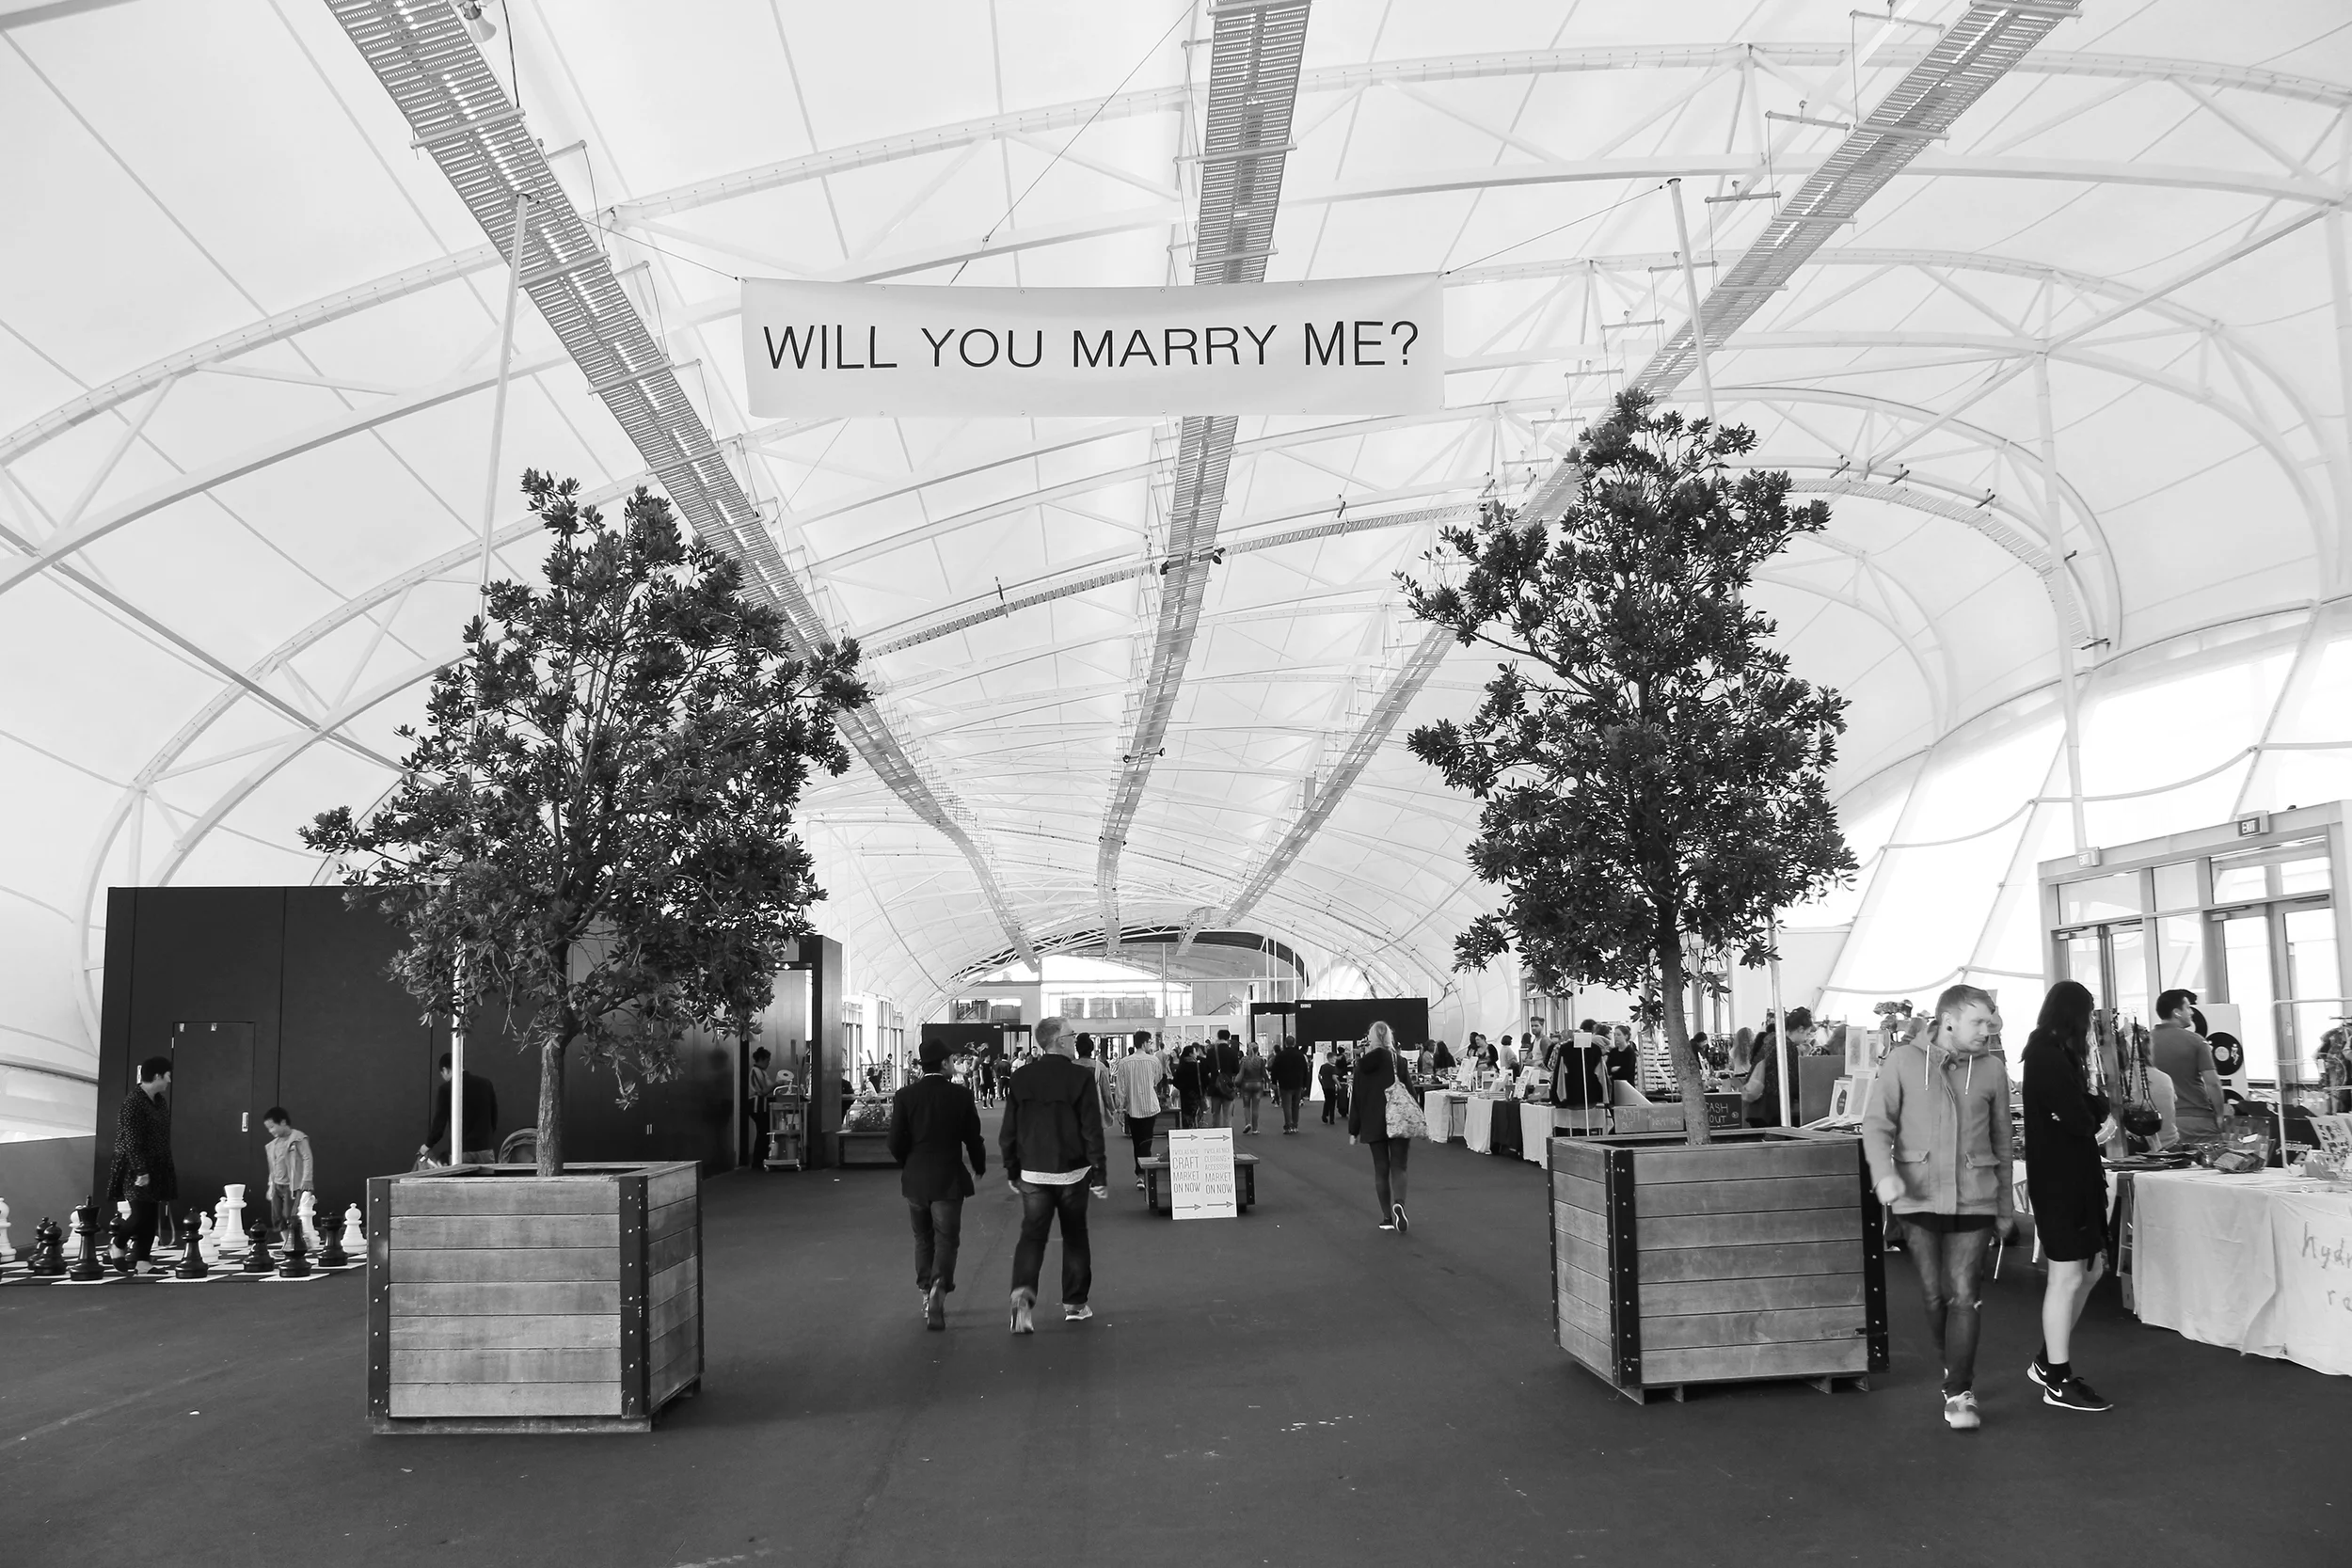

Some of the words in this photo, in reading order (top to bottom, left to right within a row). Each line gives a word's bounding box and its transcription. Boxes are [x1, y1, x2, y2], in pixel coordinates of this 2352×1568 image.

[763, 325, 898, 370] WILL
[920, 327, 1043, 368] YOU
[1073, 325, 1278, 368] MARRY
[1304, 320, 1419, 366] ME?
[2242, 820, 2256, 833] EXIT
[1708, 1114, 1727, 1124] OUT
[1621, 1121, 1633, 1130] OUT
[1172, 1157, 1199, 1169] CRAFT
[1204, 1163, 1231, 1171] ACCESSORY
[1172, 1171, 1200, 1181] MARKET
[1205, 1172, 1232, 1182] MARKET
[1173, 1183, 1184, 1194] ON
[1184, 1182, 1201, 1193] NOW
[1205, 1184, 1216, 1195] ON
[1216, 1183, 1233, 1195] NOW
